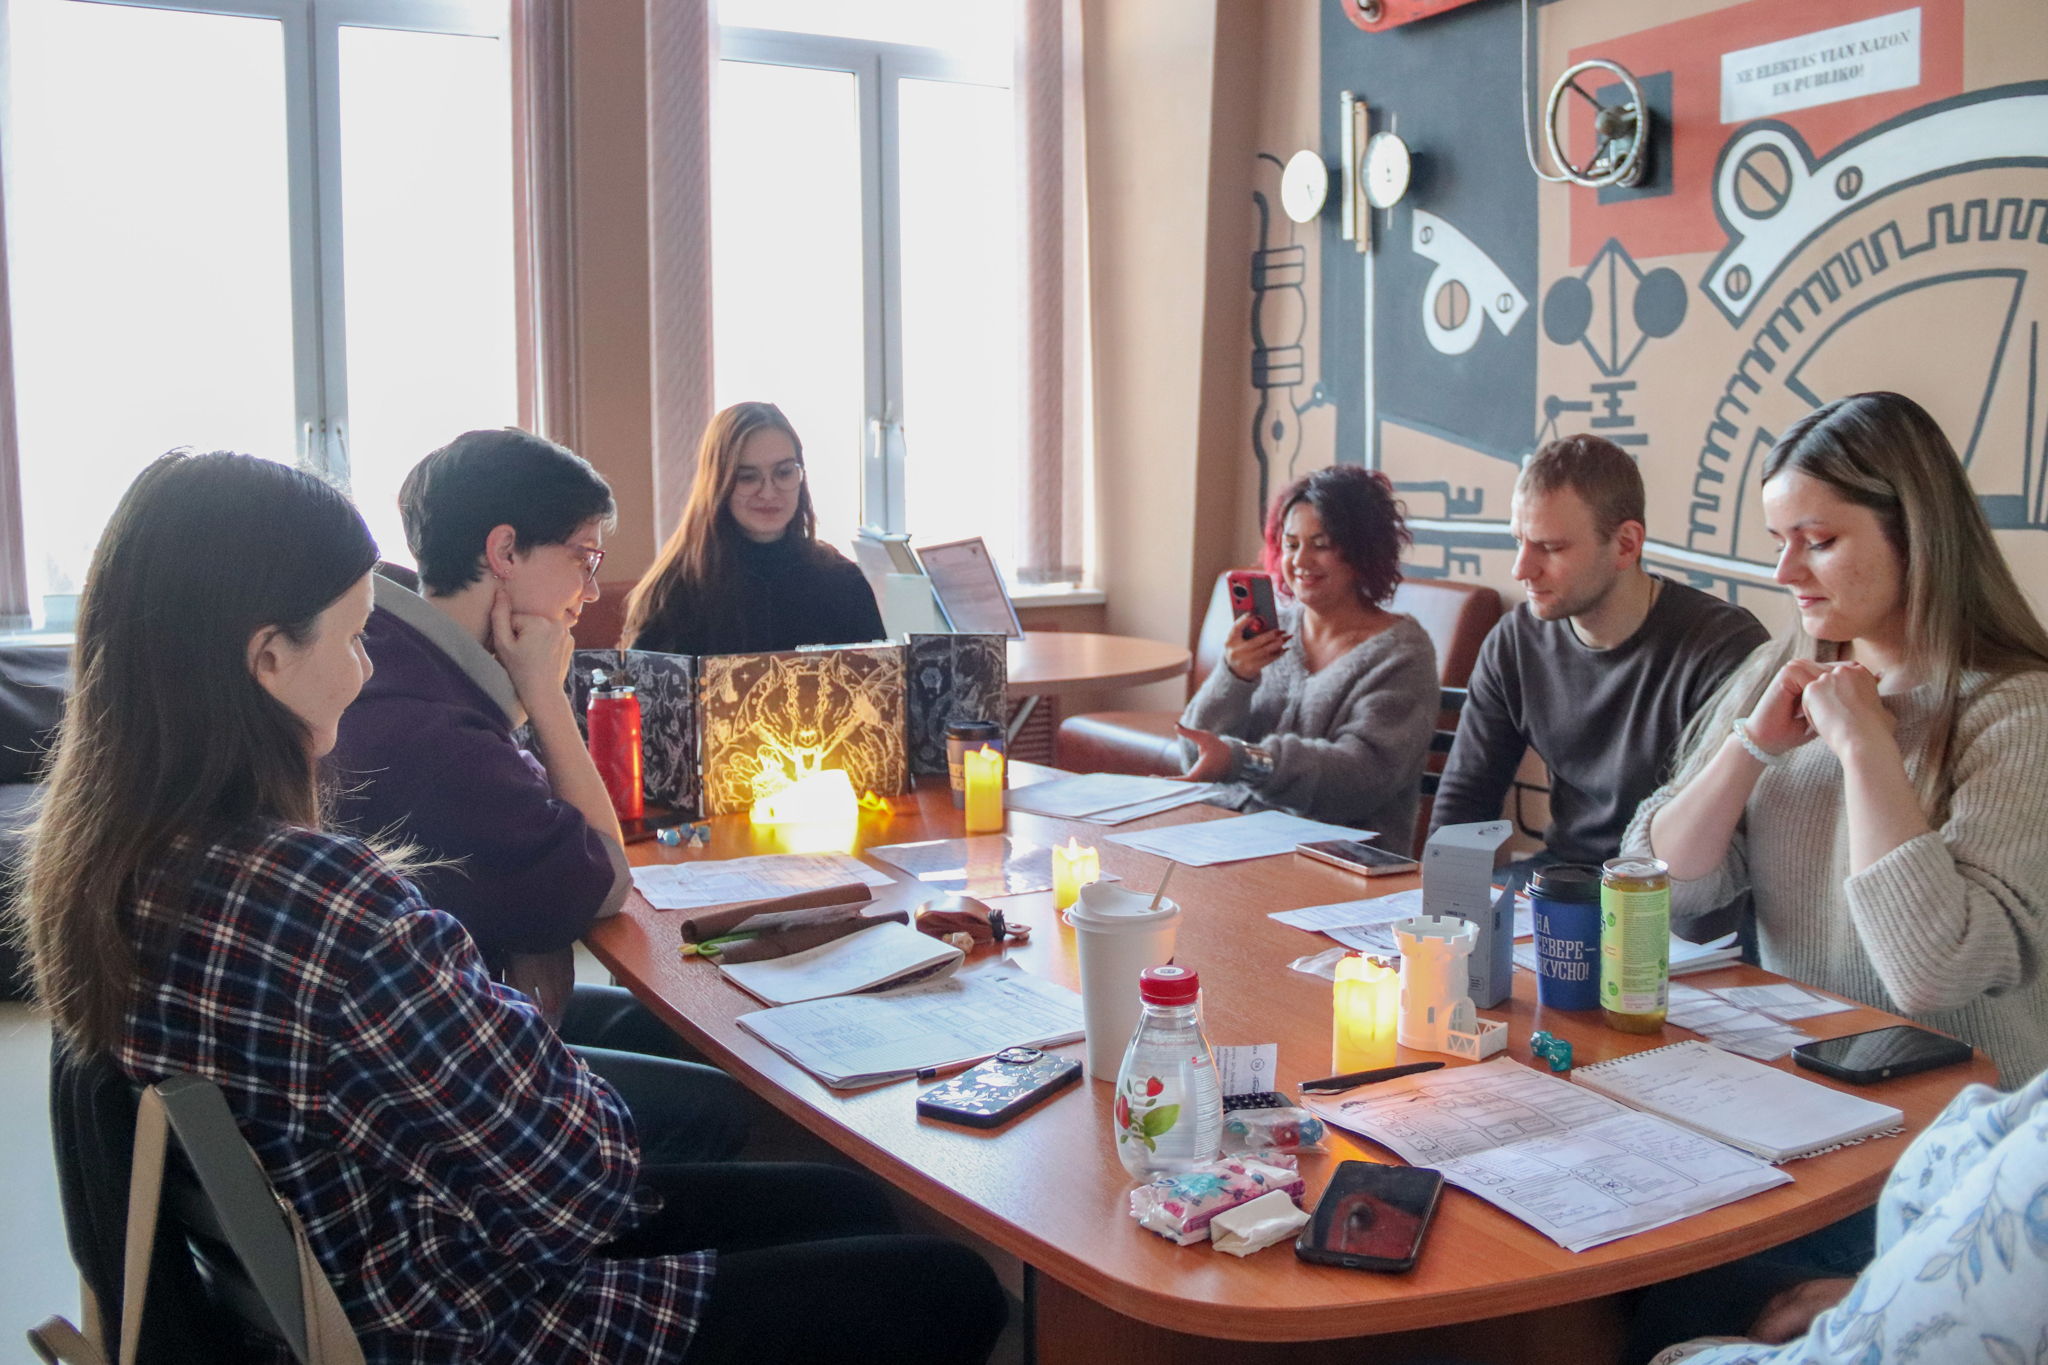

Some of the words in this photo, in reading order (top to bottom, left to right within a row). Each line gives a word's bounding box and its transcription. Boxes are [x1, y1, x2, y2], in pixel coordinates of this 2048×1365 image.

[1736, 68, 1754, 84] NE
[1821, 42, 1857, 63] VIAN
[1859, 29, 1911, 55] NAZON
[1772, 80, 1792, 97] EN
[1794, 64, 1864, 93] PUBLIKO!
[1536, 912, 1551, 935] НА
